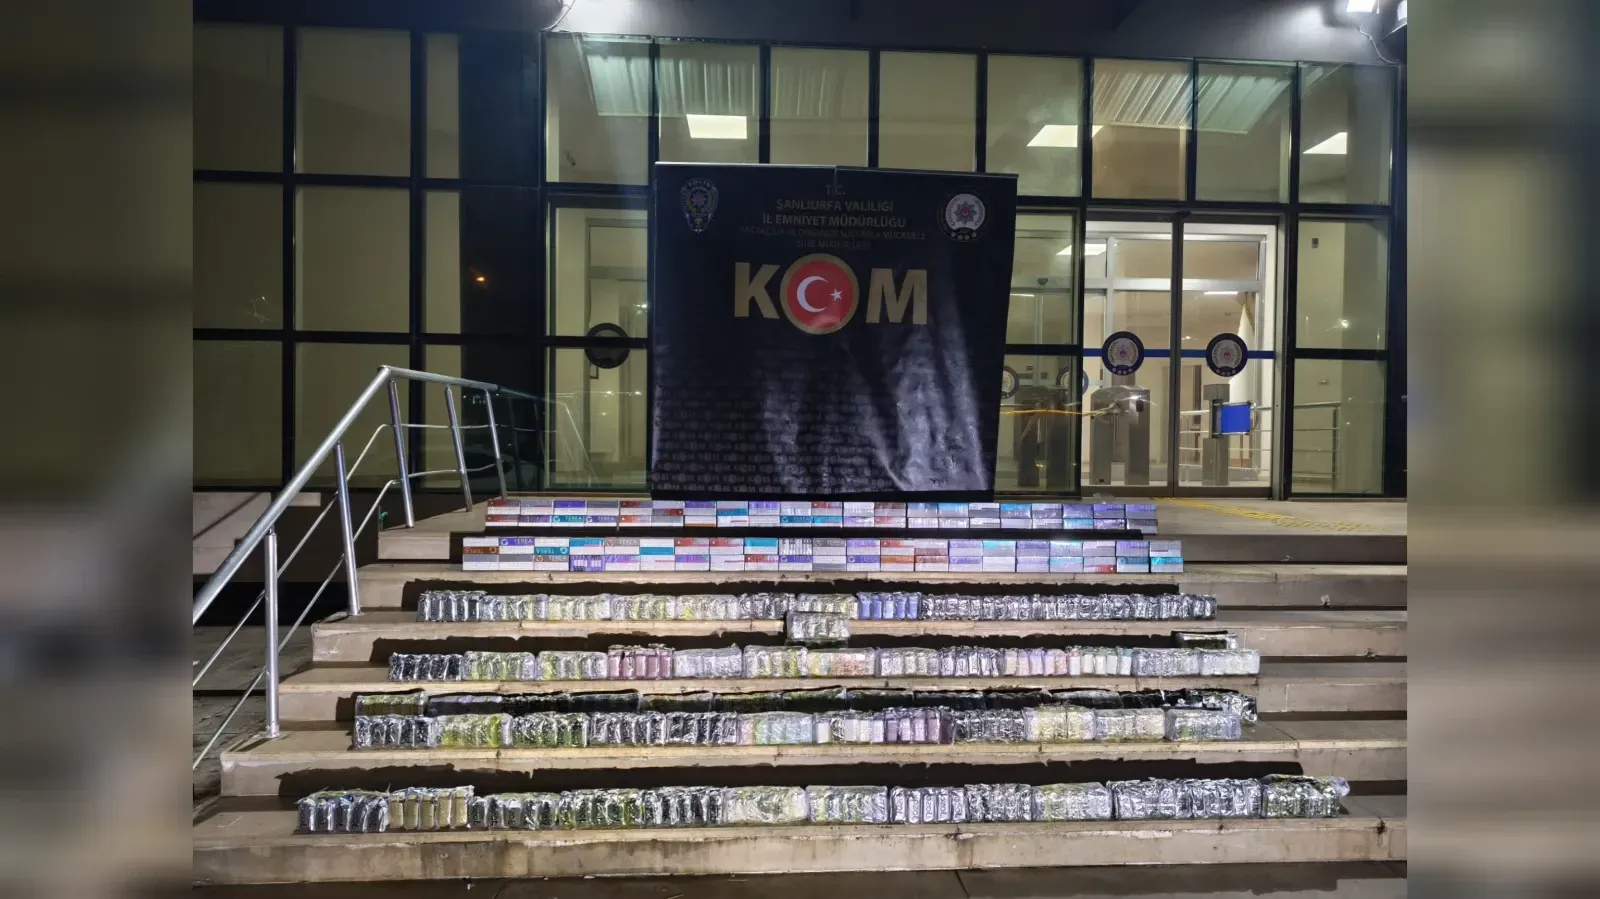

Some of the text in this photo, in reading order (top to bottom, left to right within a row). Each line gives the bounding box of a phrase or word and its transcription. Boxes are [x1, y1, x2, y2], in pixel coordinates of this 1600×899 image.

[775, 198, 894, 212] ŞANLIURFA VALİLİĞİ
[775, 213, 827, 226] EMNİYET
[828, 213, 906, 228] MÜDÜRLÜĞÜ
